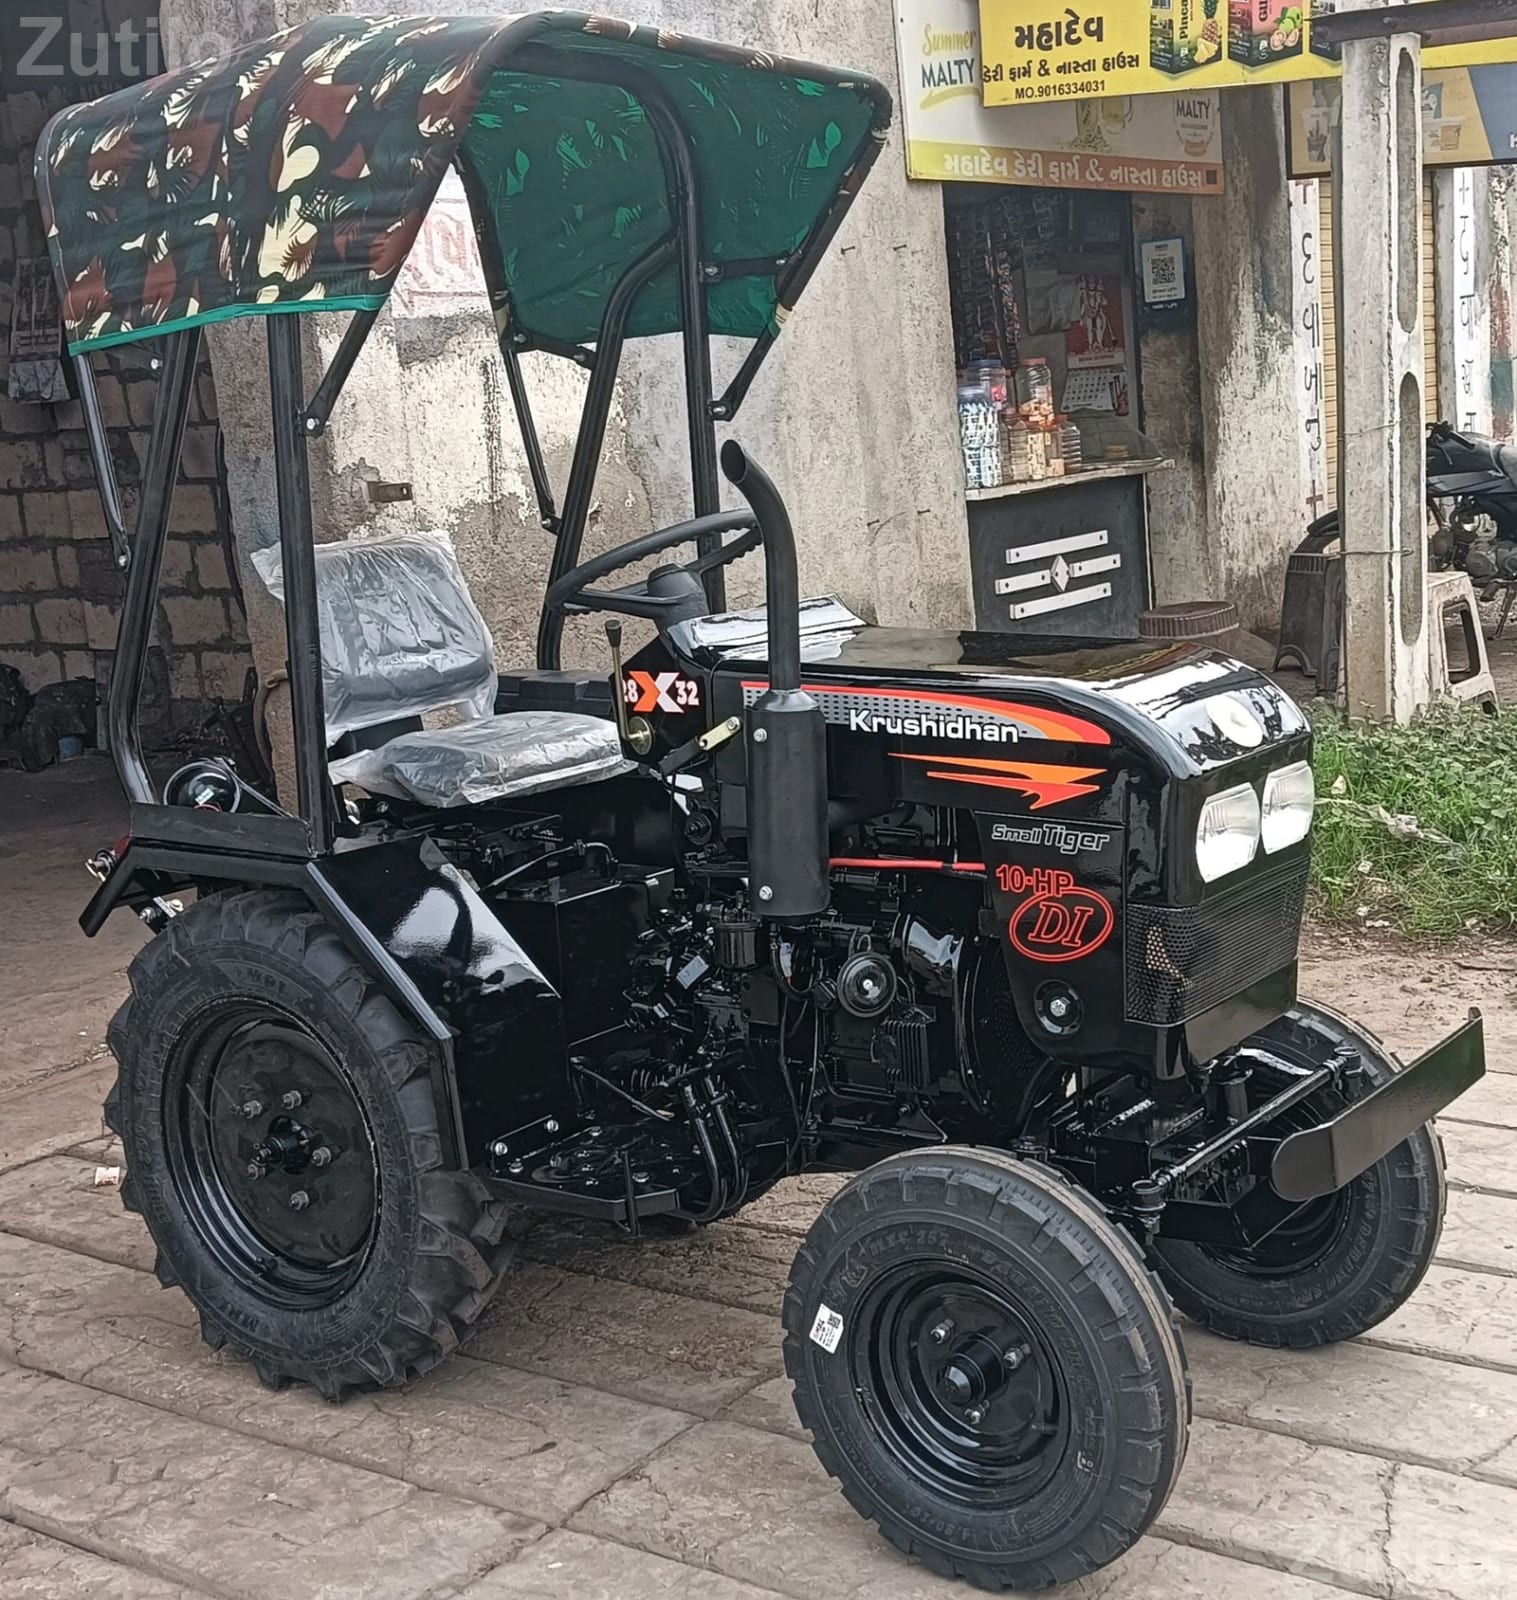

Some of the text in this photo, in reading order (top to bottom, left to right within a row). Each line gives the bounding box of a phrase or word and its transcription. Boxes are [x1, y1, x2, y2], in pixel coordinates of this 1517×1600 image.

[922, 23, 977, 56] Summer
[1014, 8, 1104, 51] મહાદેવ
[921, 57, 975, 88] MALTY
[982, 51, 1140, 83] ડેરી ફાર્મ & નાસ્તા હાઉસ
[1015, 79, 1106, 100] MO.9016334031
[1176, 98, 1212, 120] MALTY
[943, 147, 1202, 188] મહાદેવ ડેરી ફાર્મ & નાસ્તા હાઉસ
[849, 708, 1019, 743] Krushidhan
[992, 823, 1110, 855] Small Tiger
[996, 864, 1074, 898] 10-HP
[1028, 901, 1094, 947] DI
